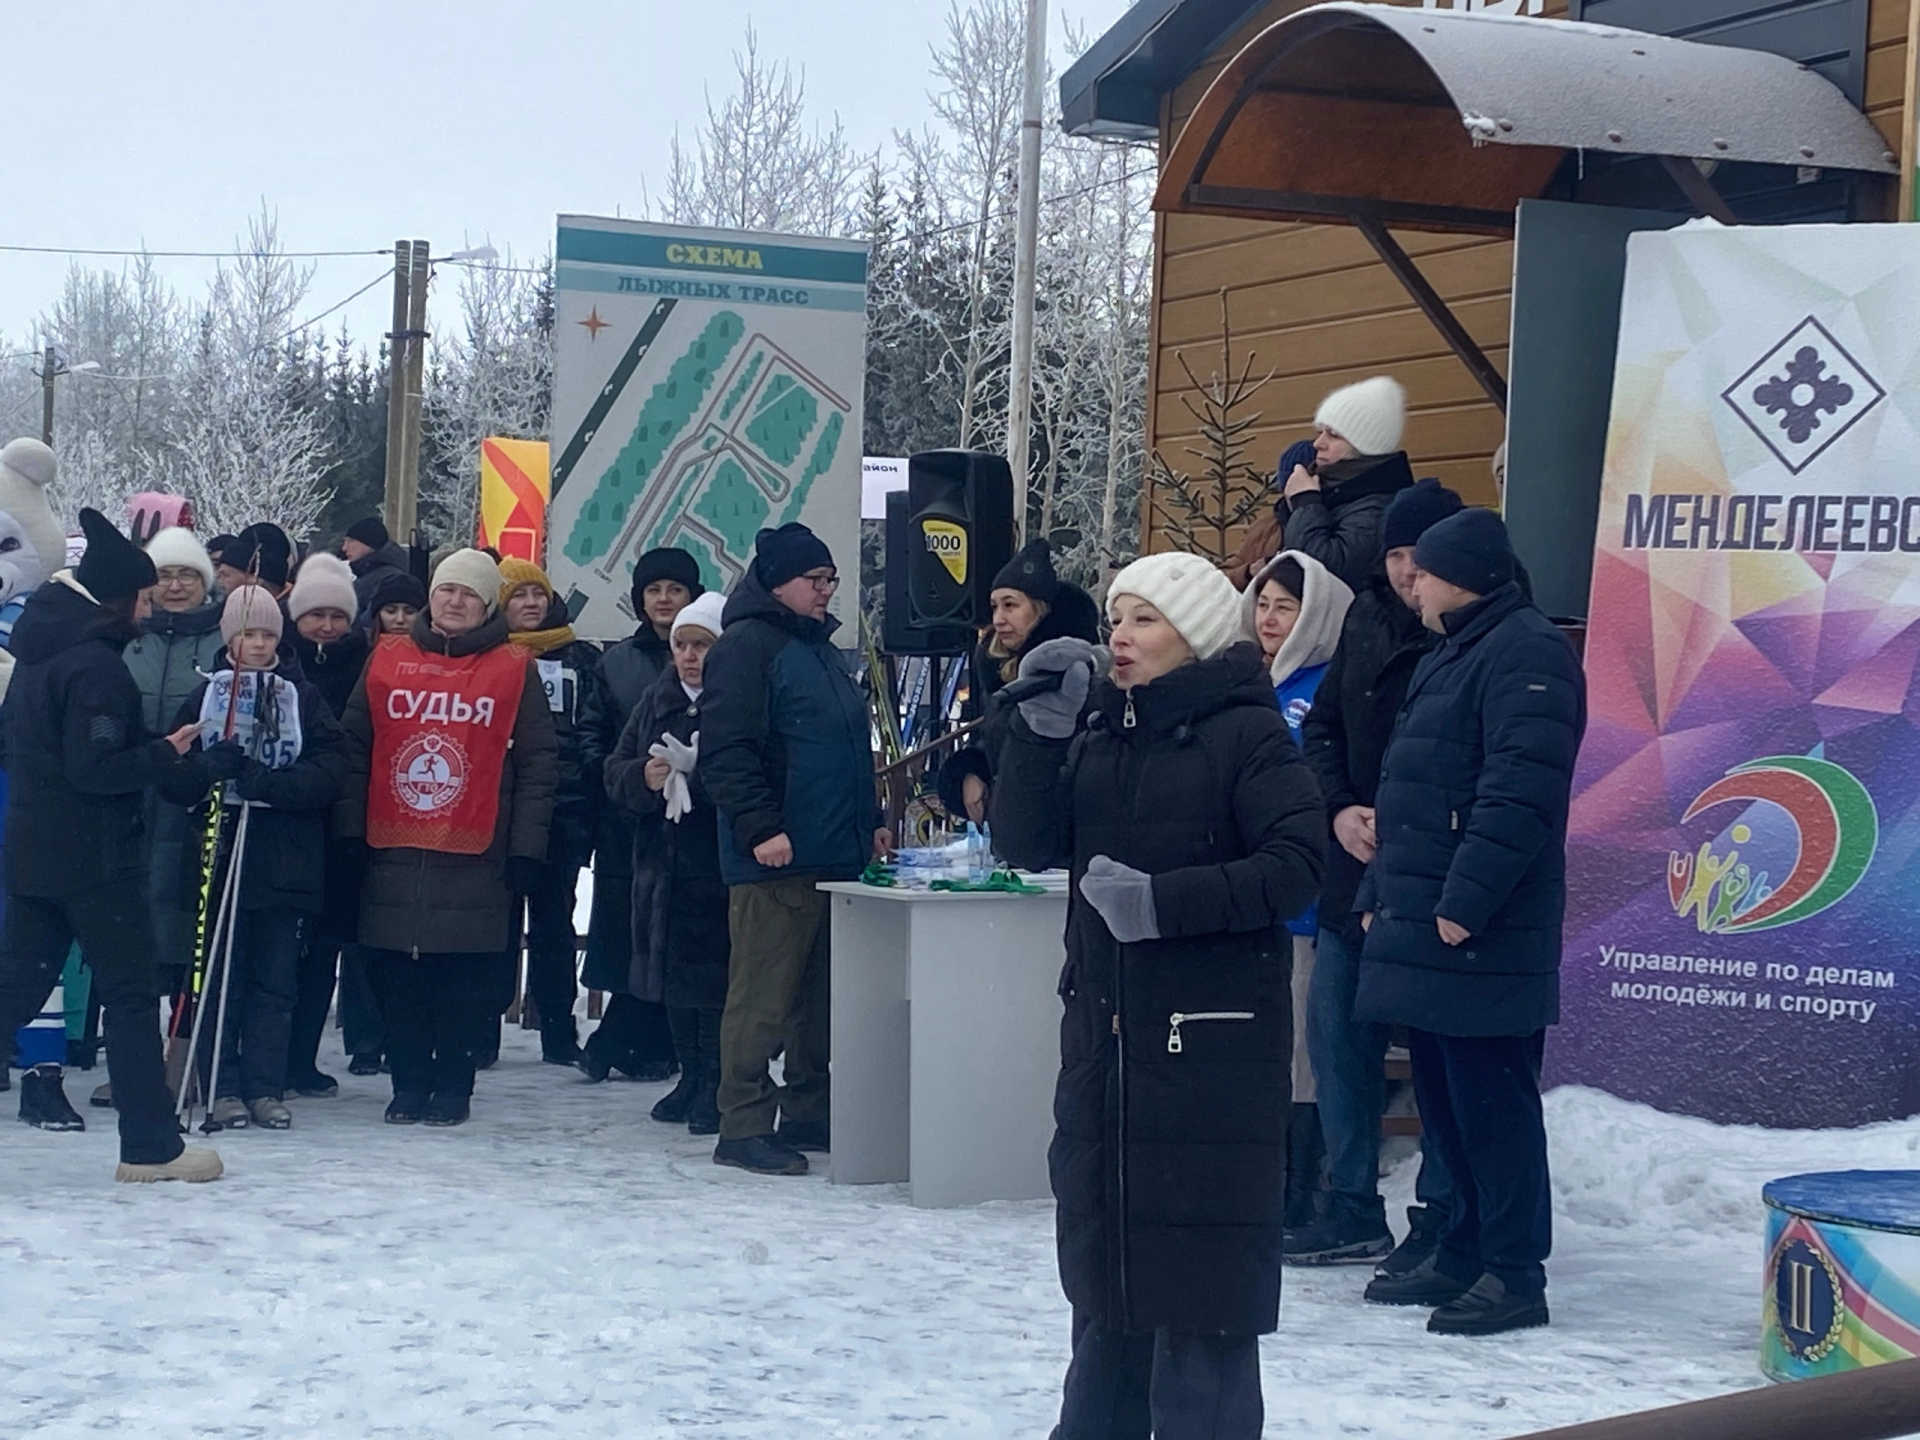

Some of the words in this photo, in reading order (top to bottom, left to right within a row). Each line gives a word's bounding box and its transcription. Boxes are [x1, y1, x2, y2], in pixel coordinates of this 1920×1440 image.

[666, 244, 763, 269] СХЕМА
[618, 276, 731, 299] ЛЫЖНЫХ
[738, 286, 809, 305] ТРАСС
[925, 534, 961, 550] 1000
[388, 689, 495, 727] СУДЬЯ
[417, 782, 438, 793] ГТО
[1599, 945, 1757, 978] Управление
[1765, 961, 1798, 981] по
[1805, 965, 1895, 988] делам
[1611, 981, 1746, 1008] молодёжи
[1755, 992, 1770, 1009] и
[1780, 992, 1877, 1023] спорту
